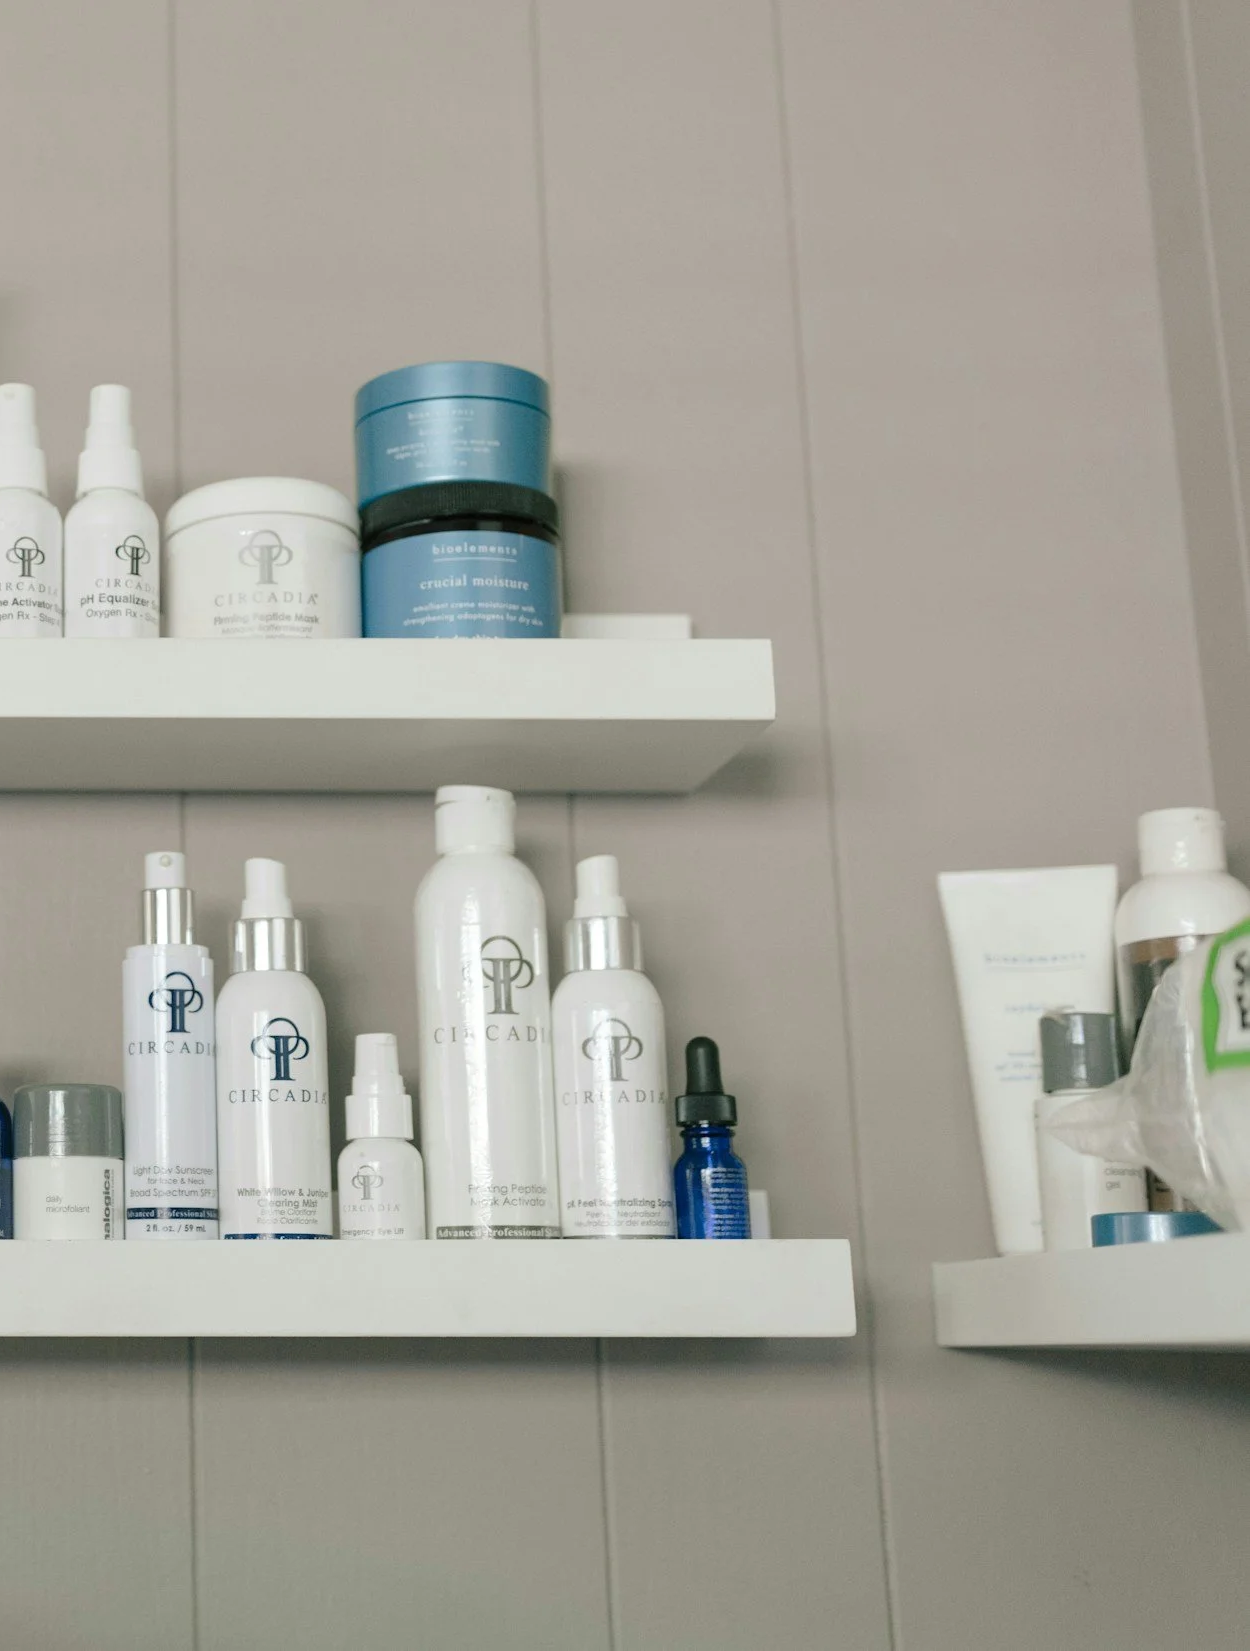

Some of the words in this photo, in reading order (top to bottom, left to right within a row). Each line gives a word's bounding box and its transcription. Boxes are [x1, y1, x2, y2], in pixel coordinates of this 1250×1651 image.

[432, 541, 517, 557] bioelements
[419, 574, 467, 590] crucial
[472, 574, 529, 591] moisture
[11, 598, 52, 610] Activator
[80, 594, 94, 608] pH
[98, 592, 149, 607] Equalizer
[17, 611, 30, 621] Rx
[86, 608, 122, 619] Oxygen
[125, 608, 137, 618] Rx
[294, 612, 320, 625] Mask
[133, 1166, 151, 1177] Light
[1105, 1181, 1121, 1192] gel
[130, 1189, 151, 1198] Broad
[153, 1188, 199, 1198] Spectrum
[237, 1188, 261, 1198] White
[265, 1188, 295, 1197] Willow
[298, 1188, 304, 1197] &
[46, 1194, 62, 1204] daily
[302, 1199, 318, 1208] Mist
[46, 1205, 90, 1214] microfoliant
[184, 1224, 194, 1232] 59
[394, 1227, 405, 1235] Lift
